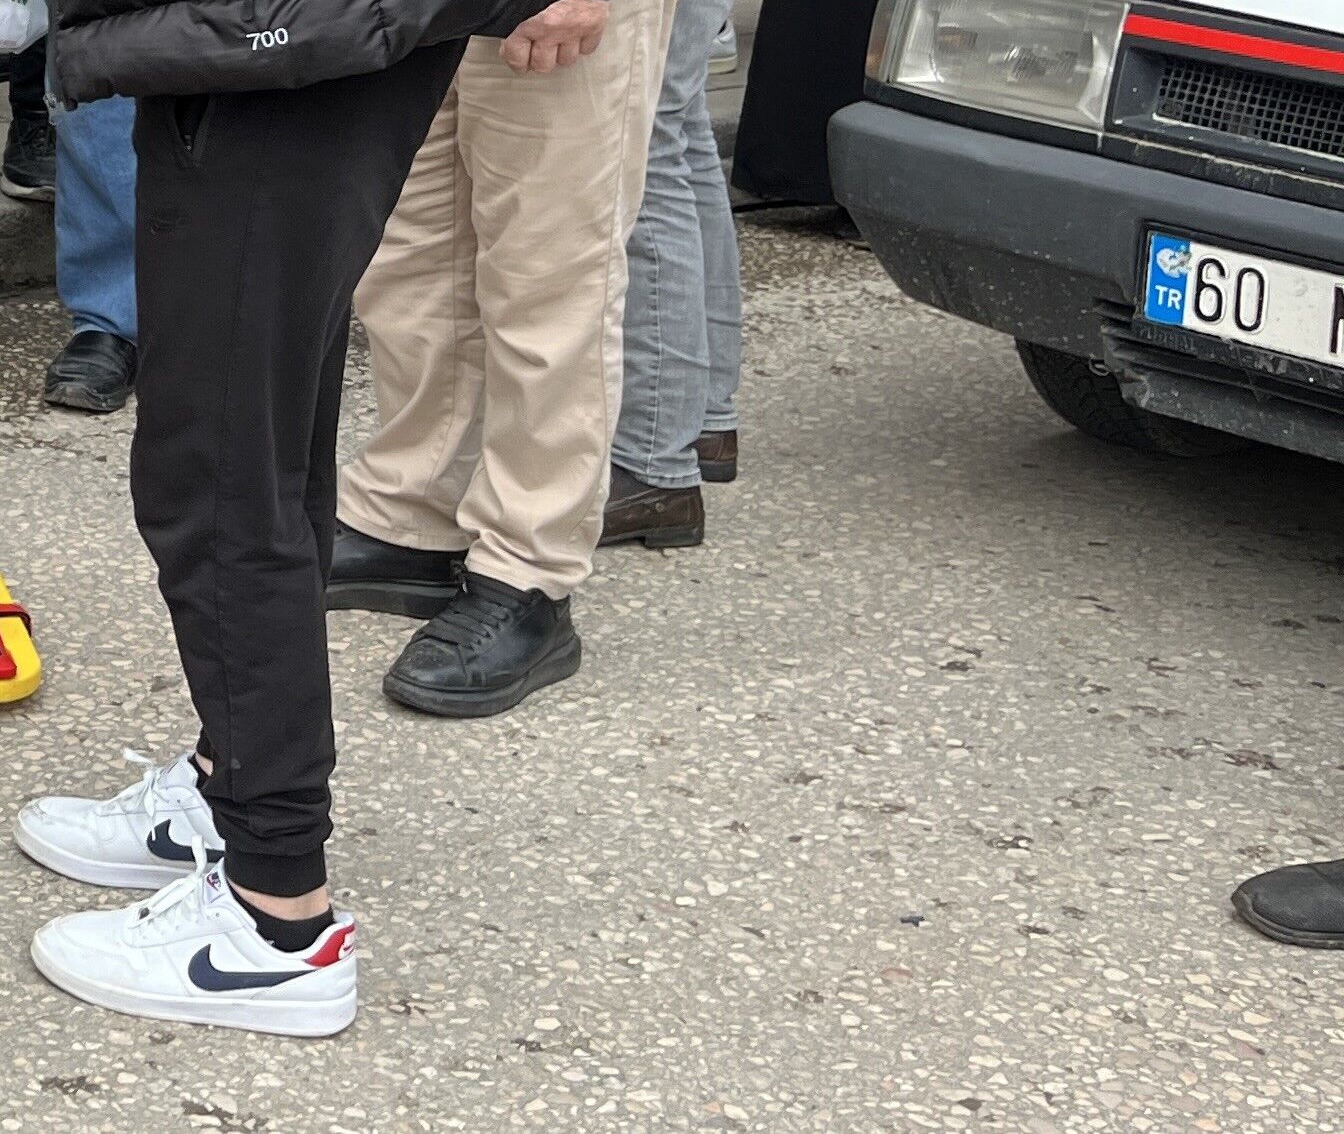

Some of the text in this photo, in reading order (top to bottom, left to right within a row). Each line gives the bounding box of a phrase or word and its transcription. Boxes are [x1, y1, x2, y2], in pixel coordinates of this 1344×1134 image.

[245, 27, 289, 51] 700
[1154, 284, 1183, 311] TR
[1194, 257, 1266, 332] 60
